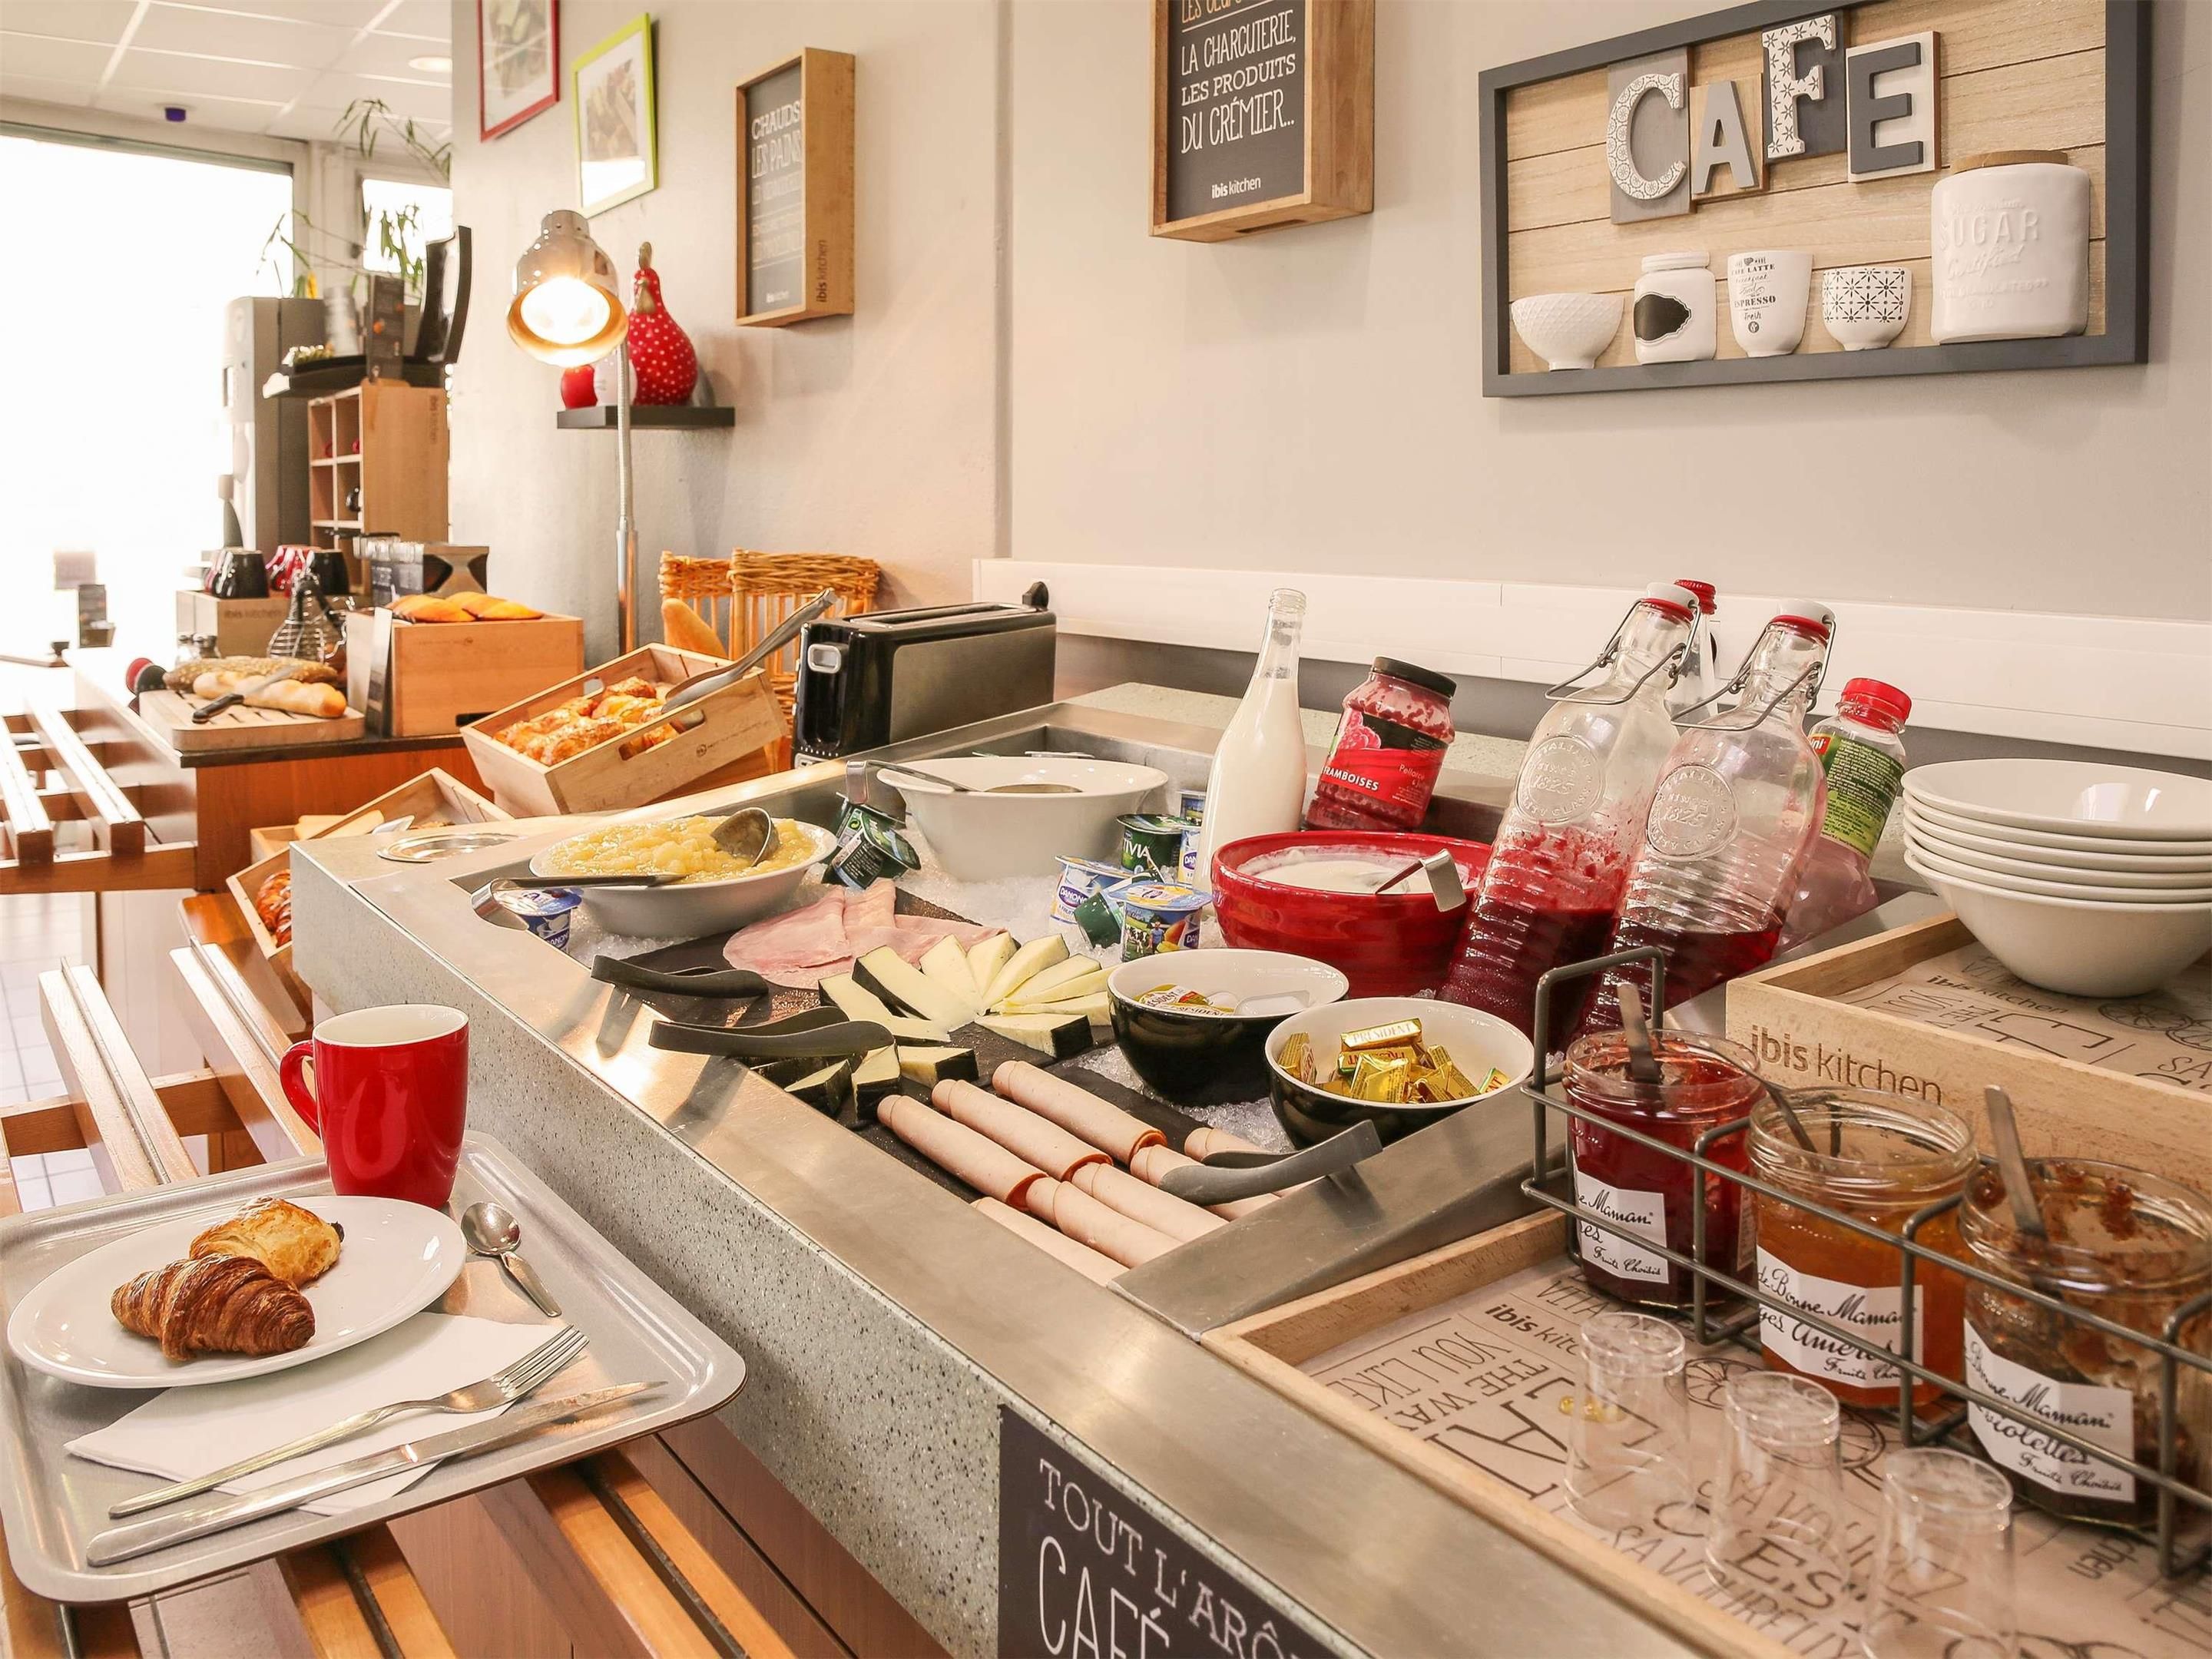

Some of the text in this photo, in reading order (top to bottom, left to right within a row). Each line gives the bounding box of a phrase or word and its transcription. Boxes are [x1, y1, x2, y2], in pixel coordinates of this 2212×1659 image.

[1181, 9, 1296, 76] LA CHARCUTERIE,
[1181, 53, 1296, 106] LES PRODUITS
[751, 100, 800, 140] CHAUDS
[1181, 88, 1295, 154] DU CRÉMIER...
[1606, 14, 1924, 201] CAFE
[1211, 177, 1261, 199] ibis kitchen
[1940, 209, 2040, 250] SUGAR
[816, 282, 828, 303] ibis
[1926, 975, 2068, 1014] ibis kitchen
[1751, 1025, 1942, 1106] ibis kitchen
[1770, 1268, 1826, 1316] Bonne
[1484, 1303, 1580, 1356] ibis kitc
[1325, 1331, 1513, 1412] YOU LIKE
[1039, 1458, 1301, 1659] TOUT L'ARÔ
